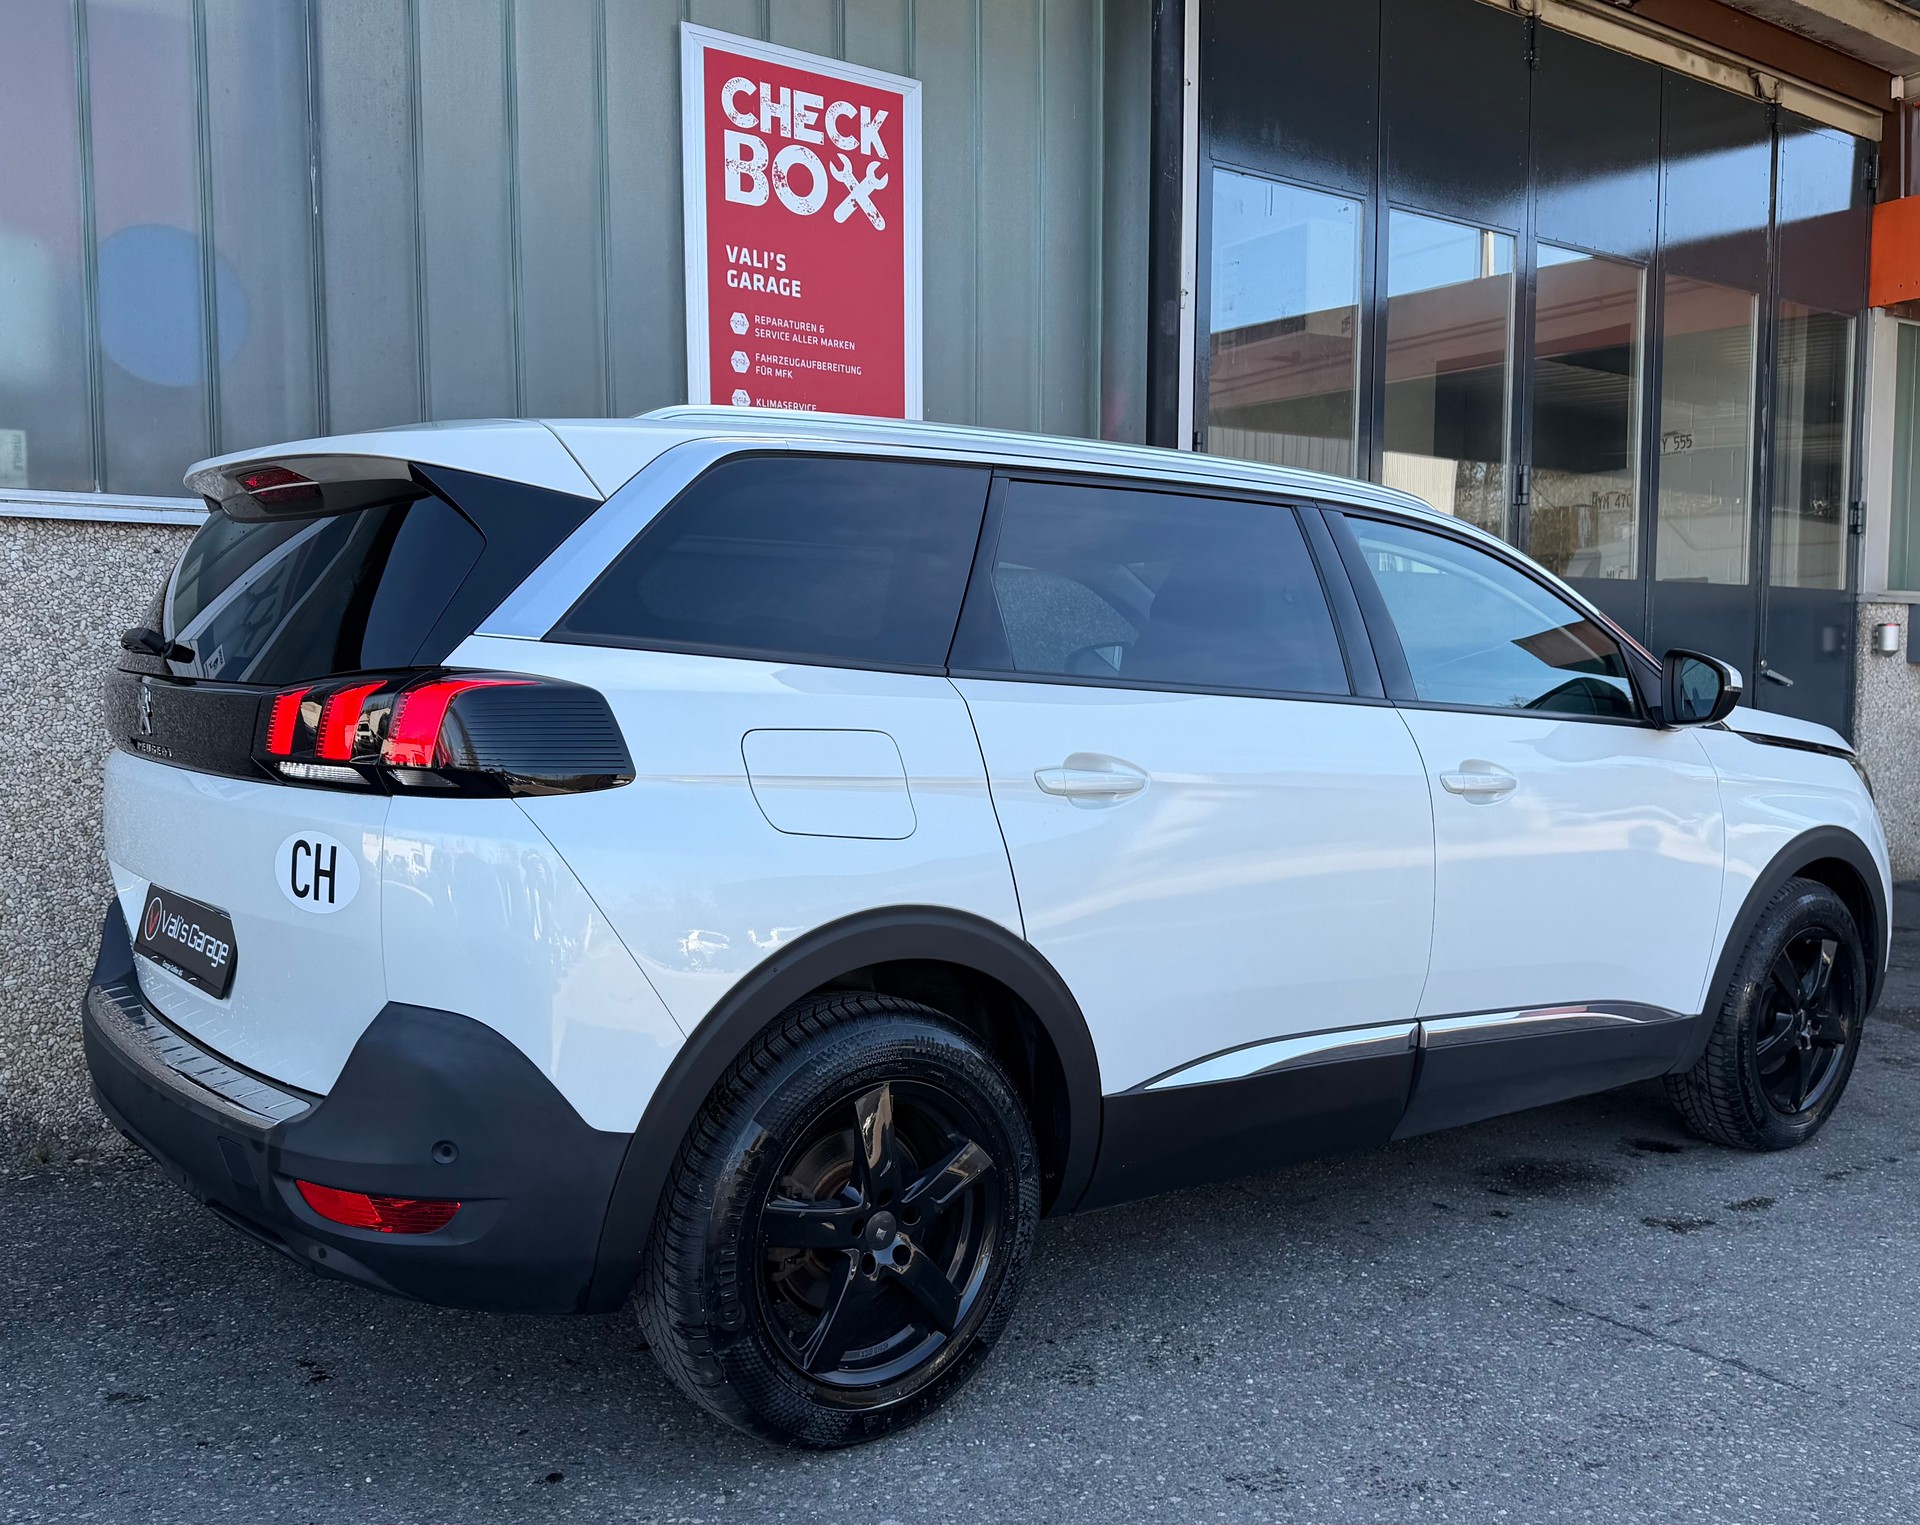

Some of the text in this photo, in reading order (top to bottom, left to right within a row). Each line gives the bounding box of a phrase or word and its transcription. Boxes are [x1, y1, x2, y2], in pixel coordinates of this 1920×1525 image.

[721, 76, 890, 160] CHECK
[724, 129, 889, 231] BOX
[725, 244, 787, 272] VALI'S
[726, 269, 802, 298] GARAGE
[754, 314, 817, 332] REPARATUREN
[754, 327, 856, 351] SERVICE ALLER MARKEN
[755, 352, 862, 376] FAHRZEUGAUFBEREITUNG
[755, 365, 793, 379] FÜR MFK
[756, 398, 817, 411] KLIMASERVICE
[1673, 433, 1693, 451] 555
[136, 741, 173, 758] PEUGEOT
[290, 839, 337, 904] CH
[187, 923, 229, 968] Garage
